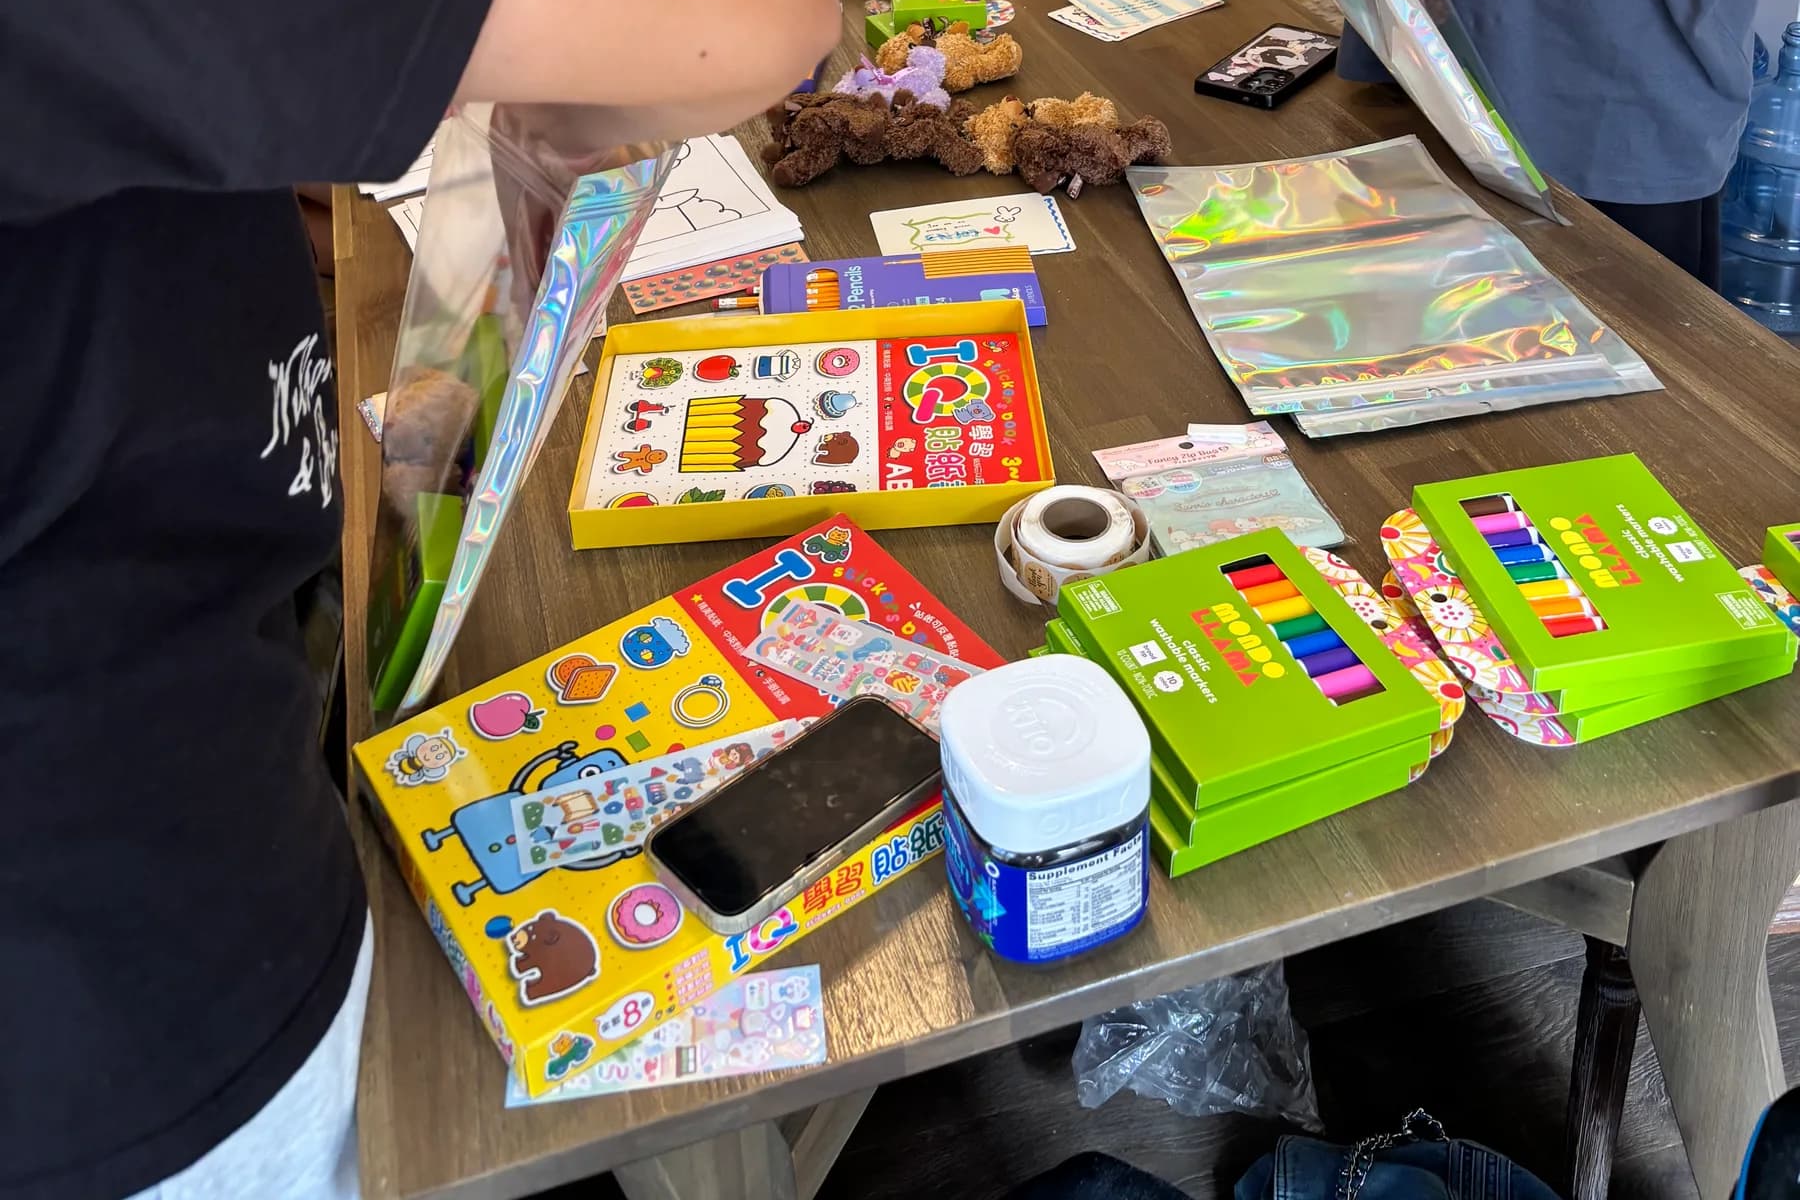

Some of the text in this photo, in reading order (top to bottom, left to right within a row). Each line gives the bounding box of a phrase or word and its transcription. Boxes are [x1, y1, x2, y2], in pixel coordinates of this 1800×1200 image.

[844, 265, 865, 305] Pencils
[903, 340, 990, 424] IQ
[1001, 412, 1016, 445] book
[1550, 517, 1620, 588] MONDO
[1575, 512, 1643, 586] LLAMA
[1615, 503, 1685, 583] washable markers
[1621, 529, 1650, 559] classic
[833, 566, 900, 623] stickers
[1149, 618, 1218, 704] washable markers
[1182, 639, 1211, 672] classic
[1190, 608, 1260, 687] LLAMA
[1211, 602, 1285, 678] MONDO
[1166, 675, 1178, 685] 10
[802, 861, 865, 915] 學習
[1029, 834, 1142, 881] Supplement Facts
[723, 907, 800, 974] IQ
